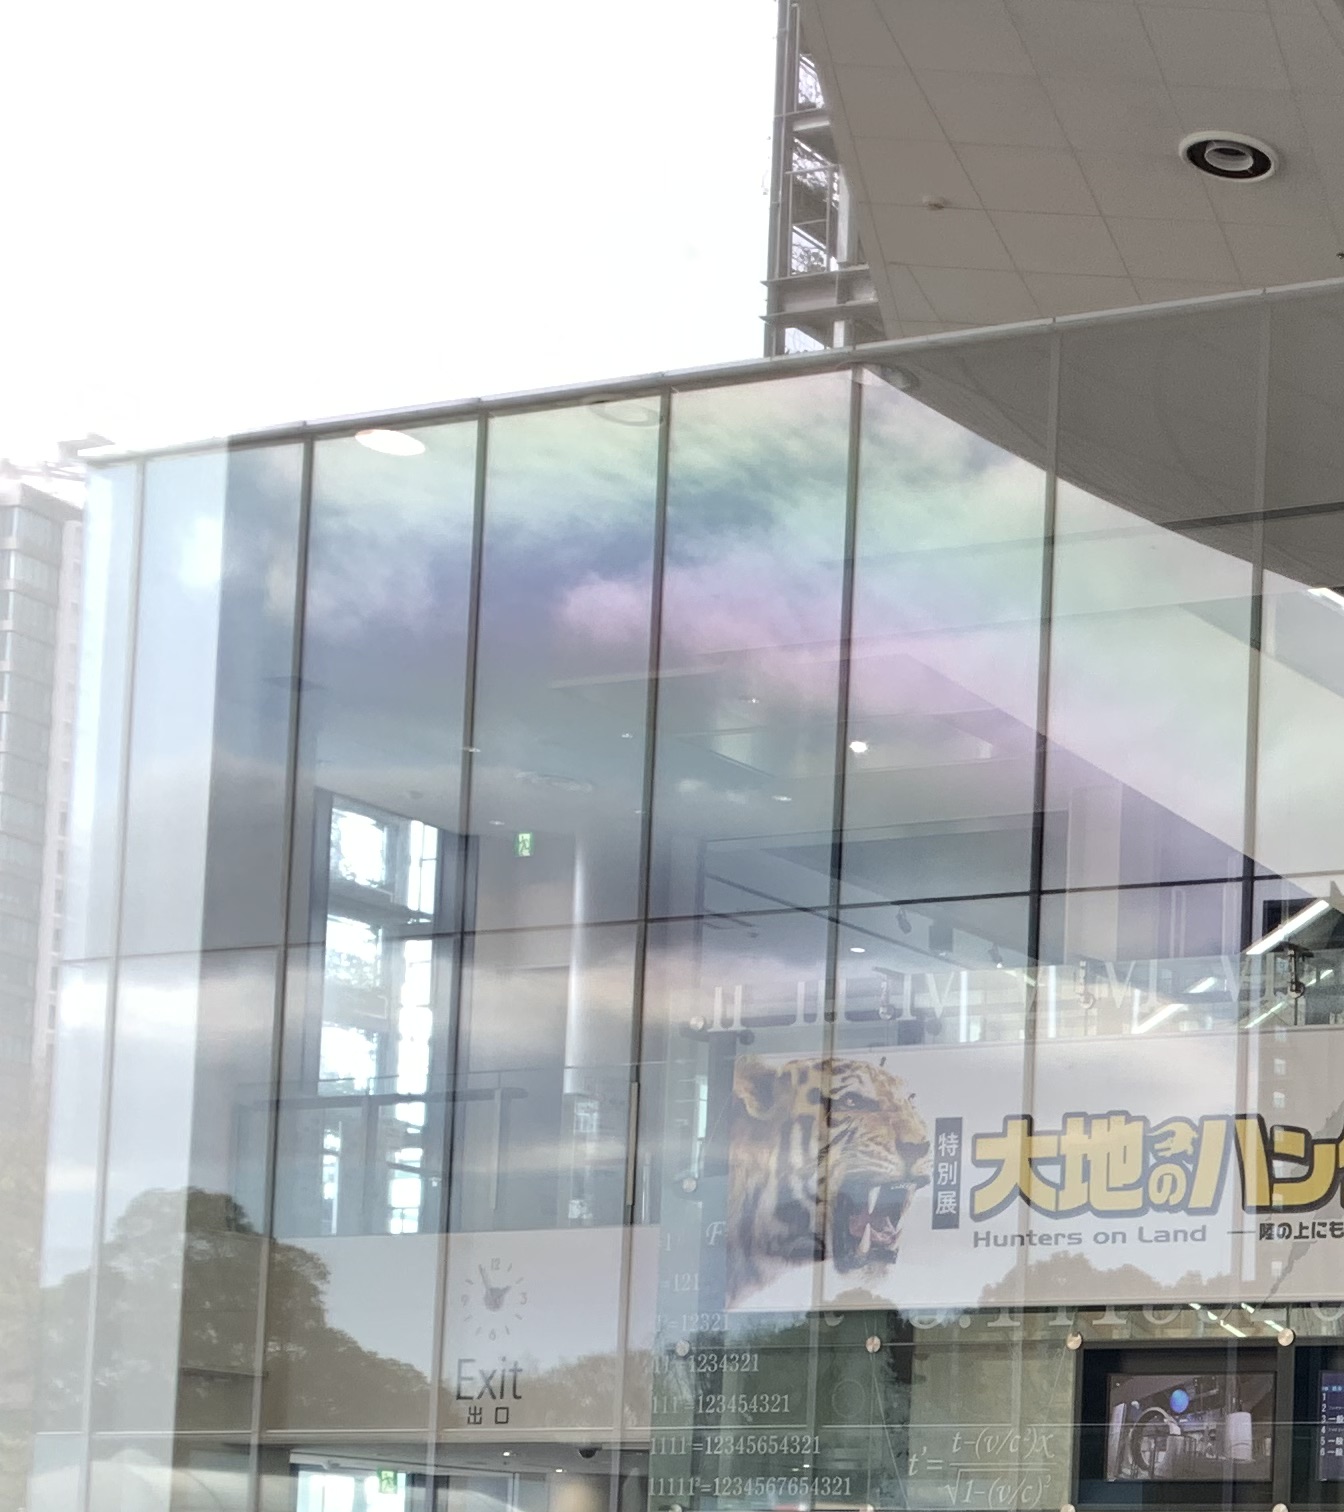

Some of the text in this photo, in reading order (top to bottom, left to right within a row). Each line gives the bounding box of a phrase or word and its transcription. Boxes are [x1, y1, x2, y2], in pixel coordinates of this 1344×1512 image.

[937, 1131, 959, 1216] 特別展
[973, 1224, 1208, 1248] Hunters on Land
[456, 1356, 523, 1400] Exit
[467, 1406, 509, 1424] 出口
